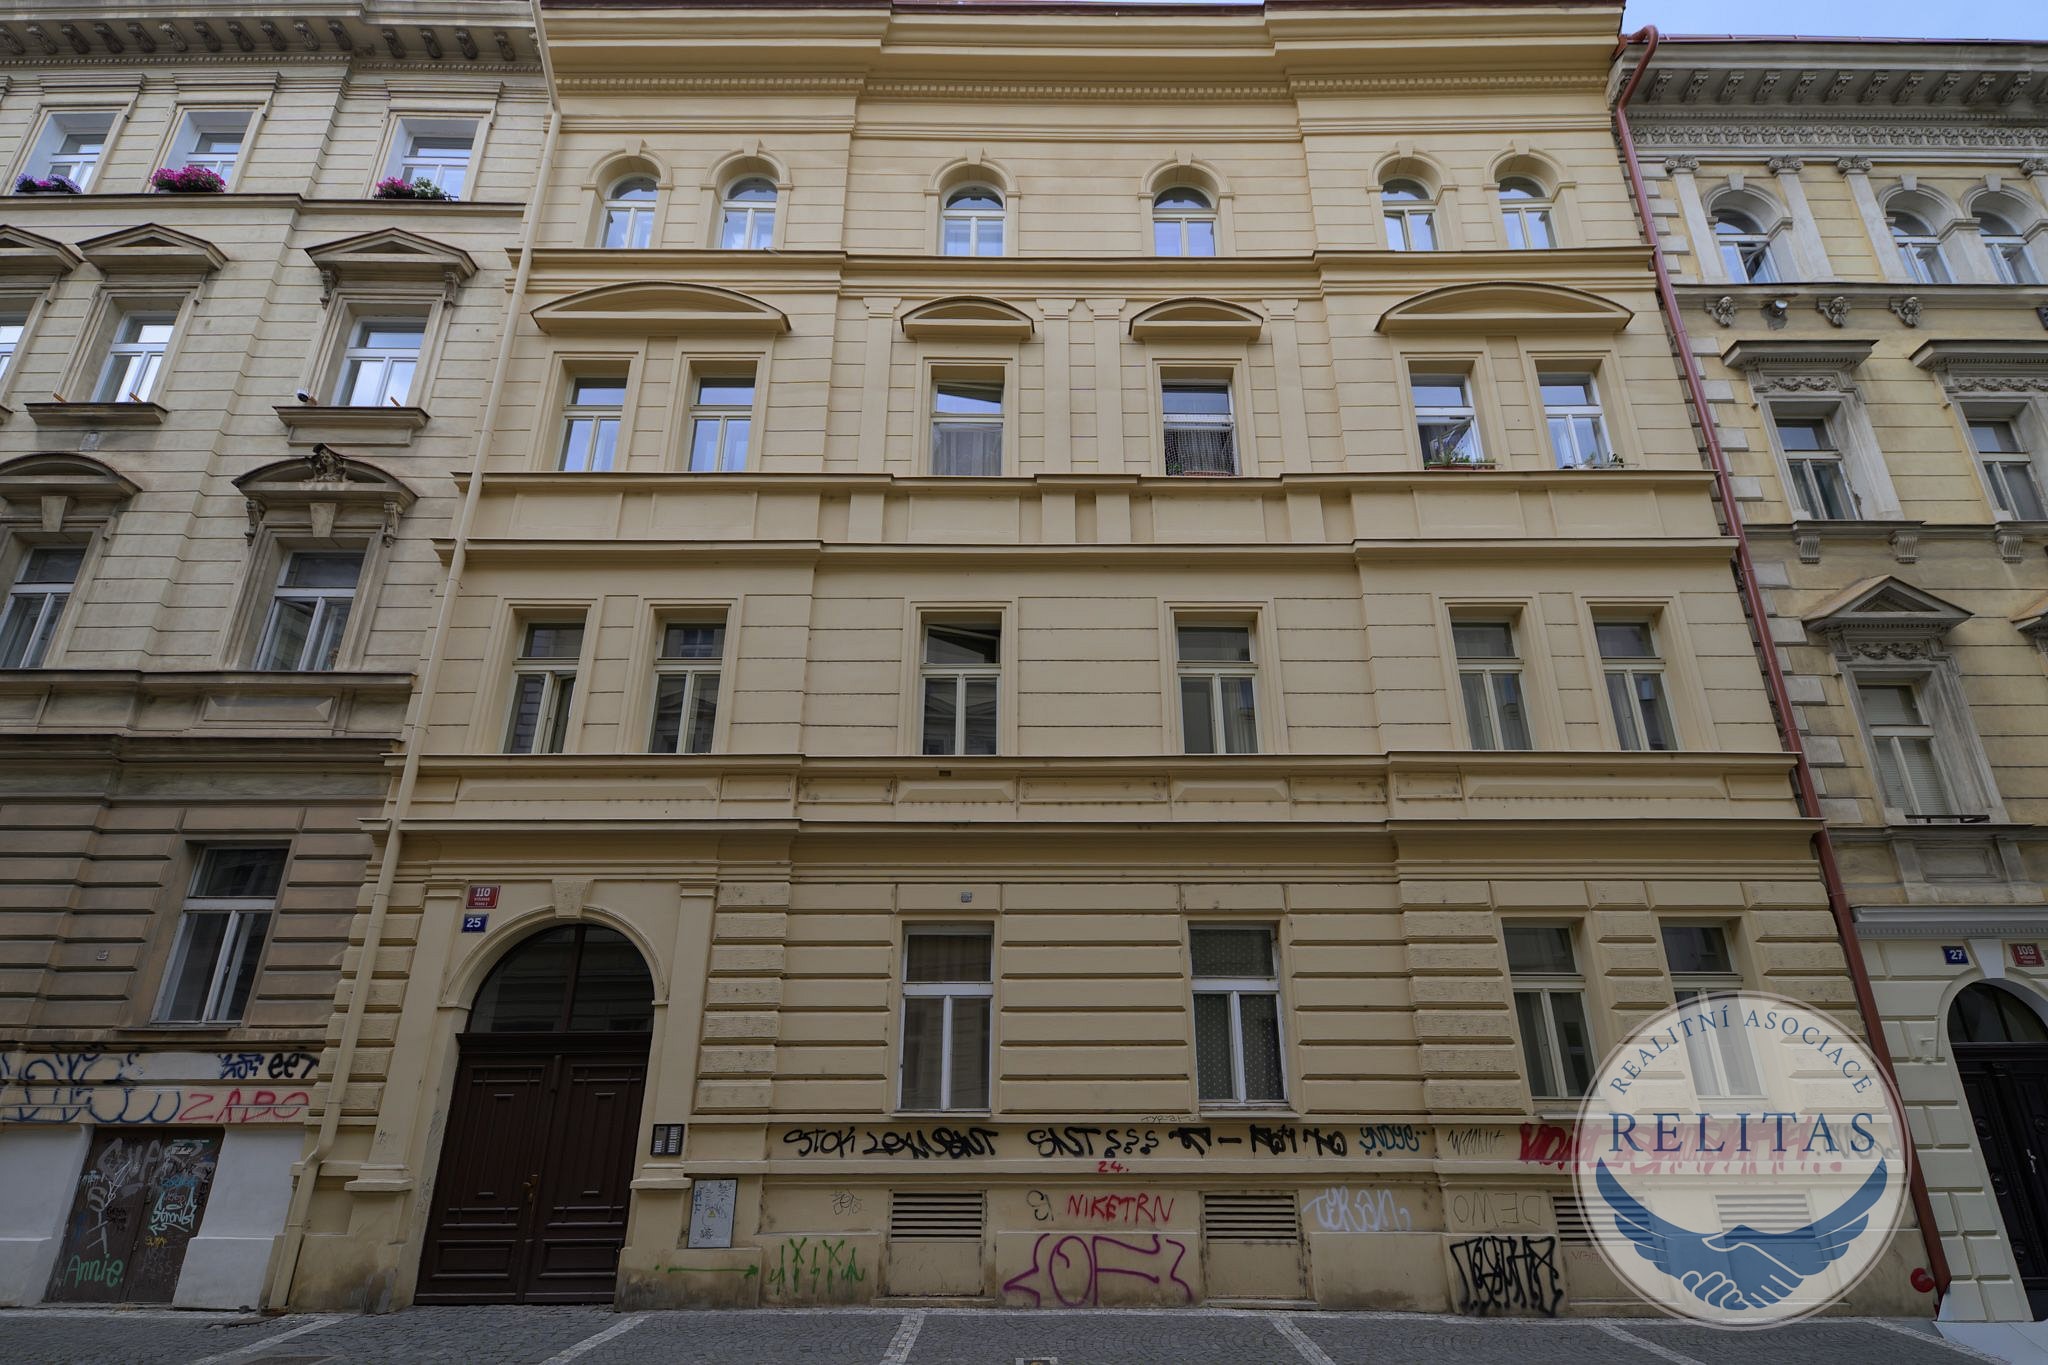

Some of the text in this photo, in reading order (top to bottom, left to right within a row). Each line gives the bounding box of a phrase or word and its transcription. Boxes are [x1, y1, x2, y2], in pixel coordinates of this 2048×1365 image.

[475, 887, 491, 897] 110
[466, 917, 482, 928] 25
[1949, 949, 1964, 960] 27
